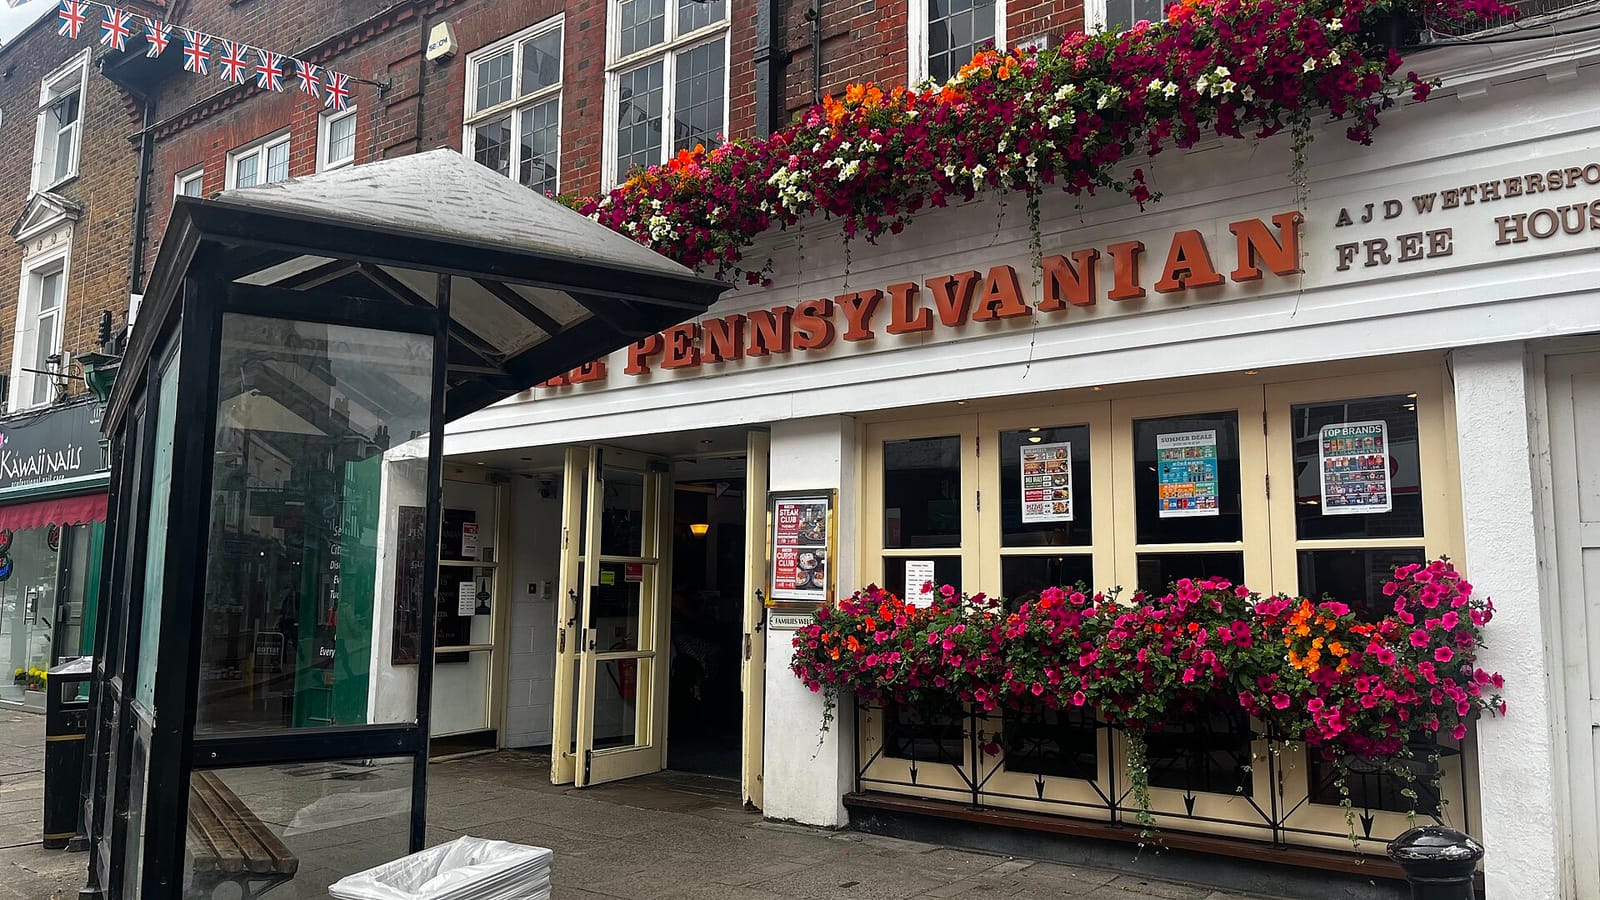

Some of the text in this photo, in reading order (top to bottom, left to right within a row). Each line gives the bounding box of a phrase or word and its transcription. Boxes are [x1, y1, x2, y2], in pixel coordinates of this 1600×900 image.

[1335, 162, 1600, 227] A J D WETHERSPO
[1336, 227, 1453, 271] FREE
[624, 210, 1304, 376] PENNSYLVANIAN
[1323, 425, 1382, 437] TOP BRANDS
[1161, 433, 1213, 443] SUMMER DEALS
[779, 508, 799, 516] STEAK
[776, 552, 798, 560] CURRY
[778, 559, 795, 567] CLUB
[775, 617, 798, 625] FAMILIES
[319, 646, 336, 659] Every
